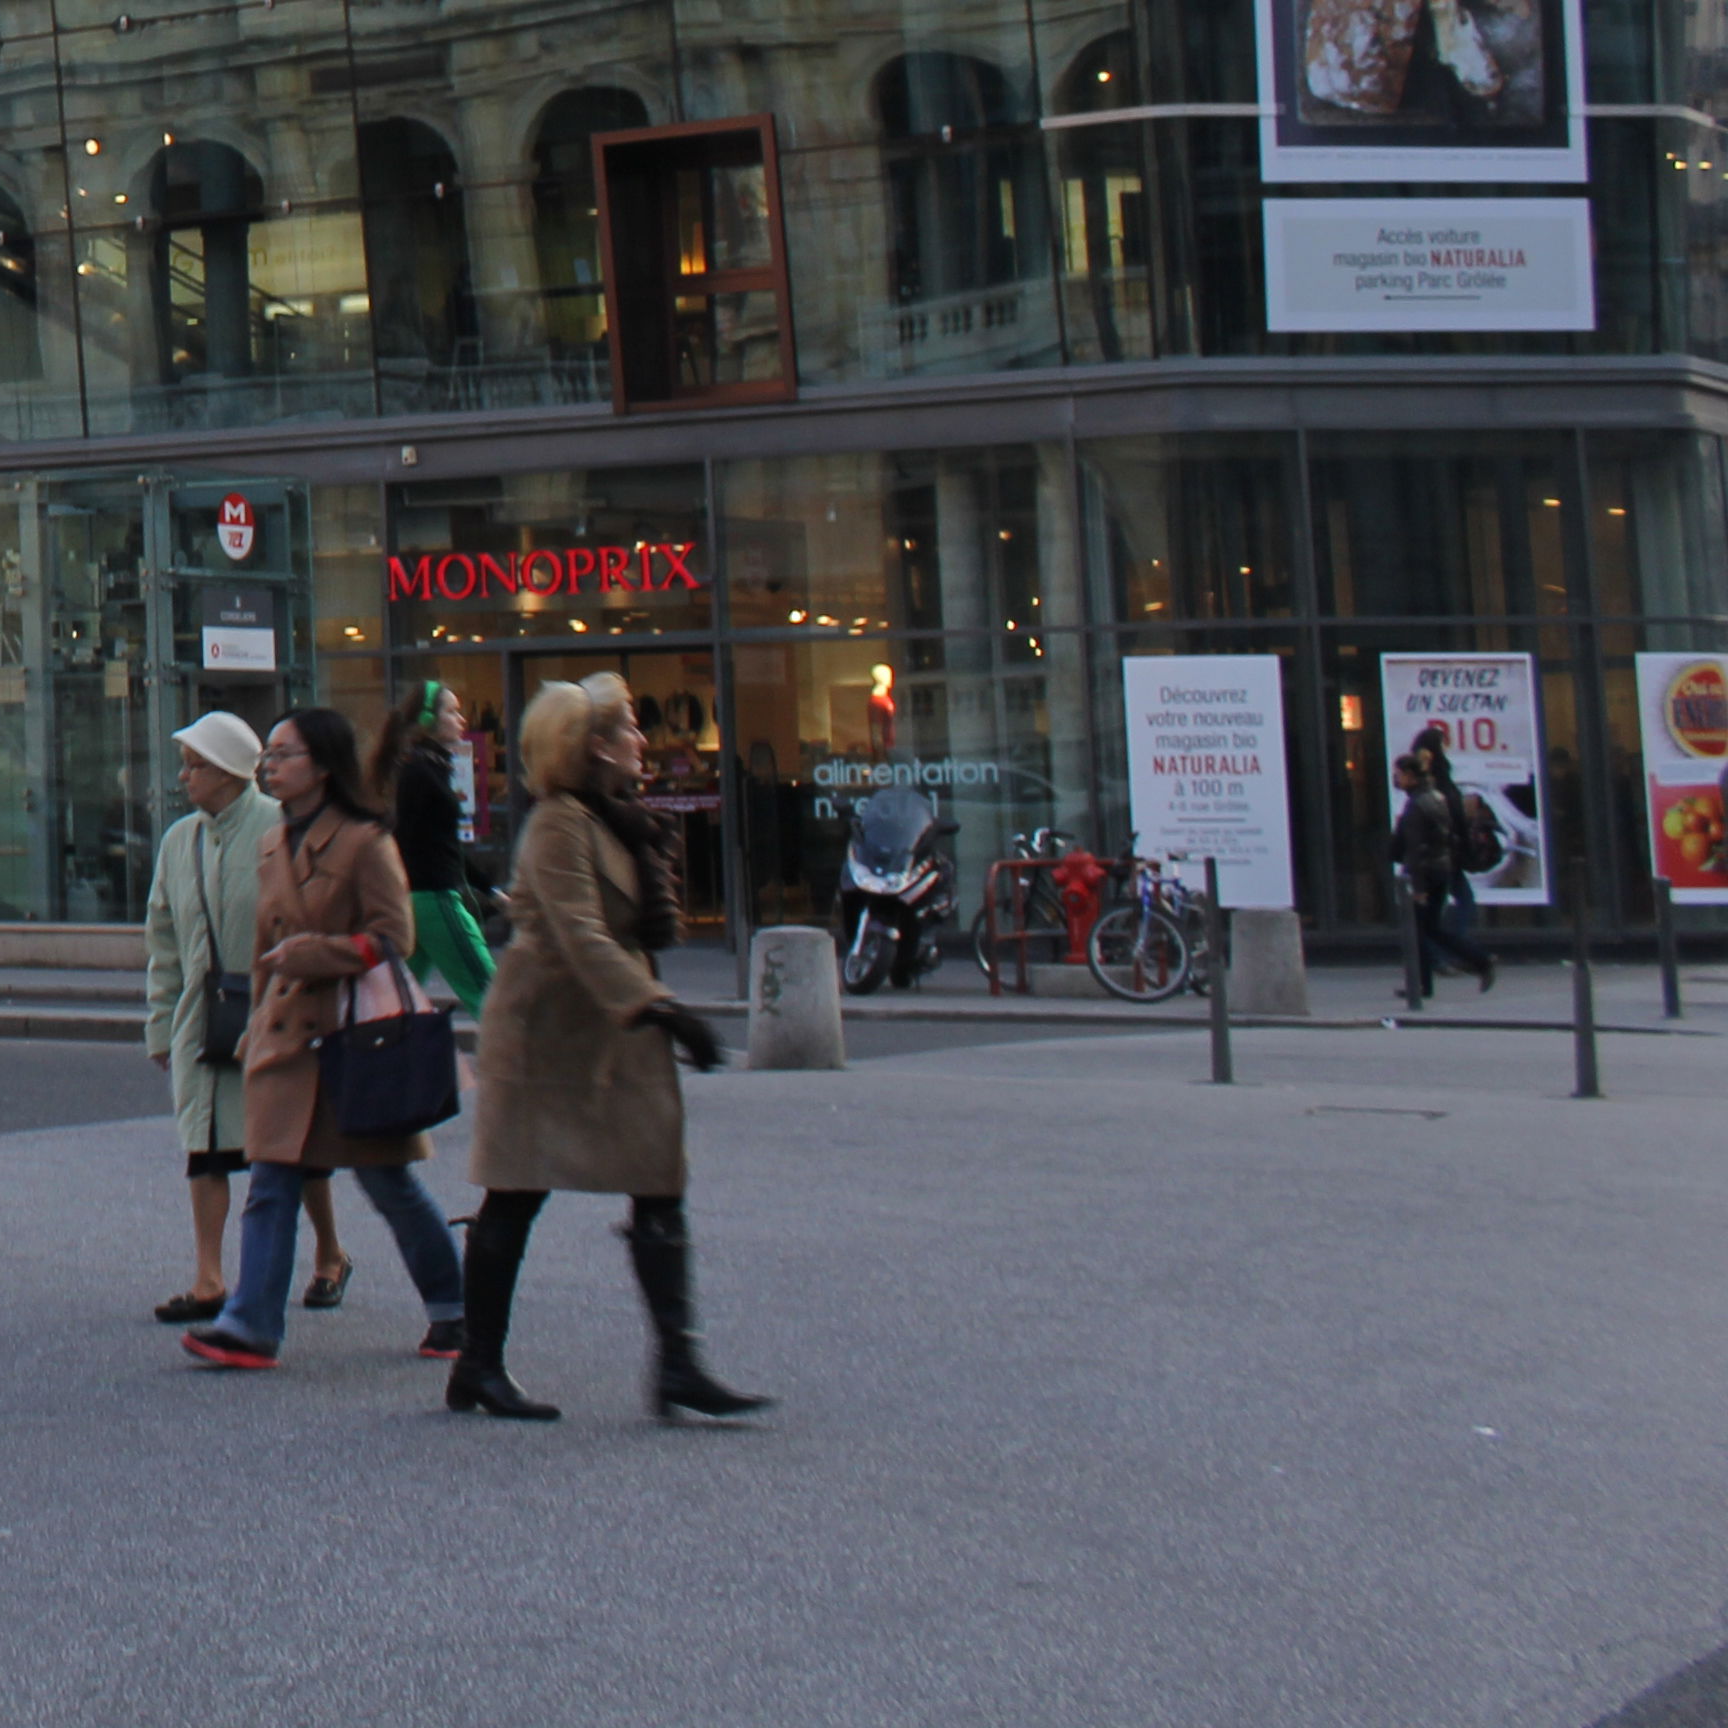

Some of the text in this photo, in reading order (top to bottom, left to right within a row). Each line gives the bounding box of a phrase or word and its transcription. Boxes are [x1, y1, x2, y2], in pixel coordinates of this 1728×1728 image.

[1428, 229, 1481, 245] voiture
[1333, 249, 1527, 270] magasin bio NATURALIA
[1355, 273, 1413, 292] parking
[1418, 271, 1452, 288] Parc
[224, 501, 246, 524] M
[387, 541, 701, 602] MONOPRIX
[1418, 668, 1500, 688] DEVENEZ
[1159, 685, 1248, 704] Découvrez
[1406, 693, 1432, 712] UN
[1146, 711, 1264, 727] votre nouveau
[1155, 732, 1257, 752] magasin bio
[813, 757, 1000, 786] alimentation
[1153, 754, 1262, 775] NATURALIA
[1173, 779, 1245, 797] à 100 m
